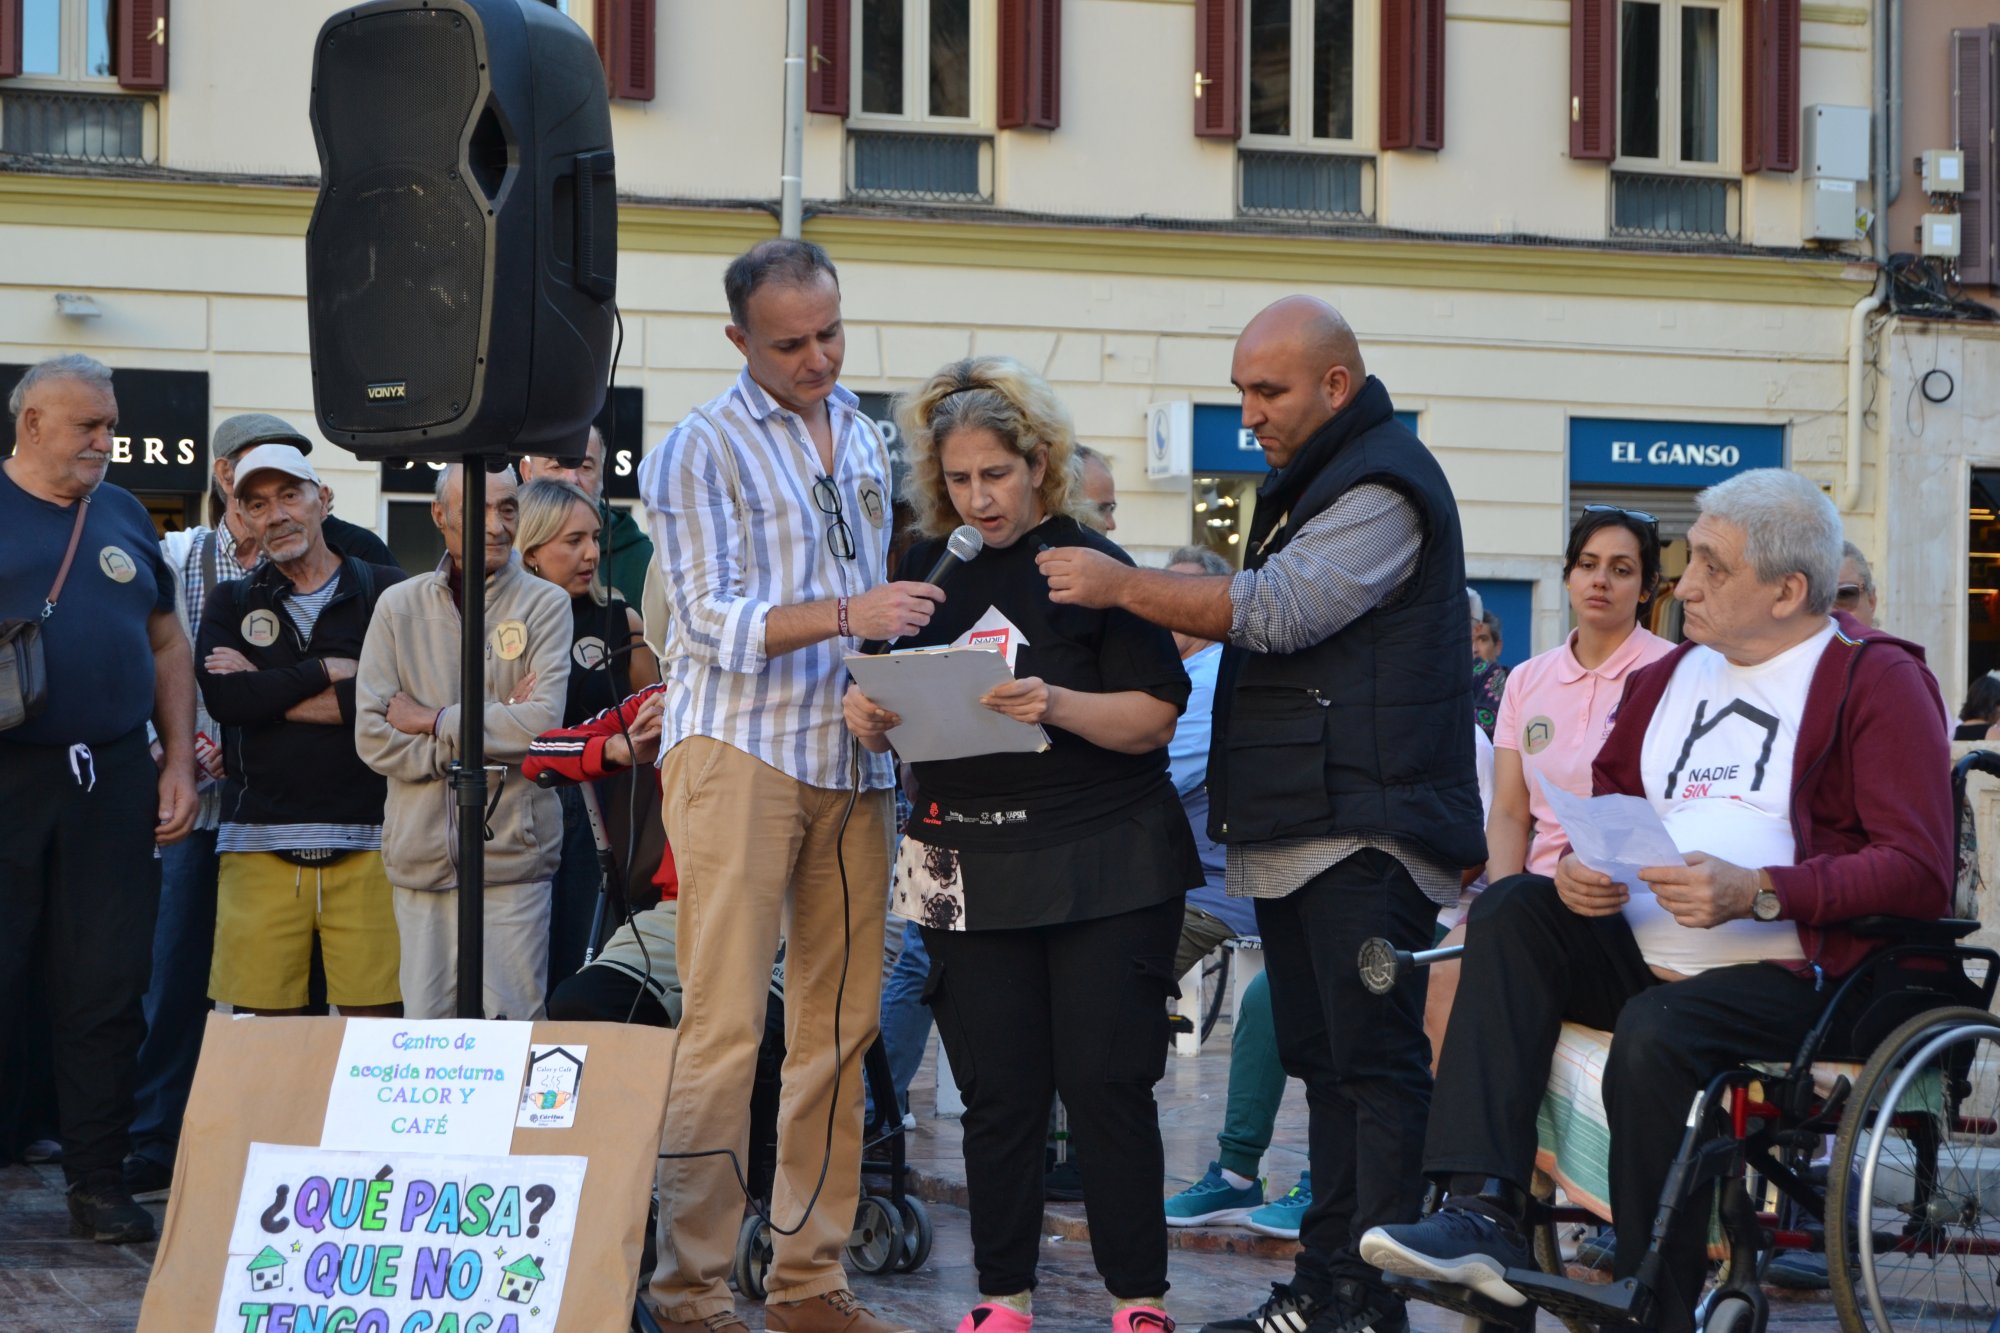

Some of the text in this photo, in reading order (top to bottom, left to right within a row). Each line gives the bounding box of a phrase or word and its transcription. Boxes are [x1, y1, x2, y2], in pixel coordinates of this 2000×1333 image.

[368, 385, 405, 398] VONYX
[1611, 441, 1740, 467] EL GANSO
[1688, 765, 1740, 782] NADIE
[1682, 783, 1712, 799] SIN
[392, 1032, 476, 1050] Centro de
[350, 1063, 505, 1082] acogida nocturna
[377, 1087, 475, 1104] CALOR Y
[391, 1114, 448, 1134] CAFÉ
[260, 1164, 556, 1238] ¿QUÉ PASA?
[304, 1241, 482, 1301] QUE NO
